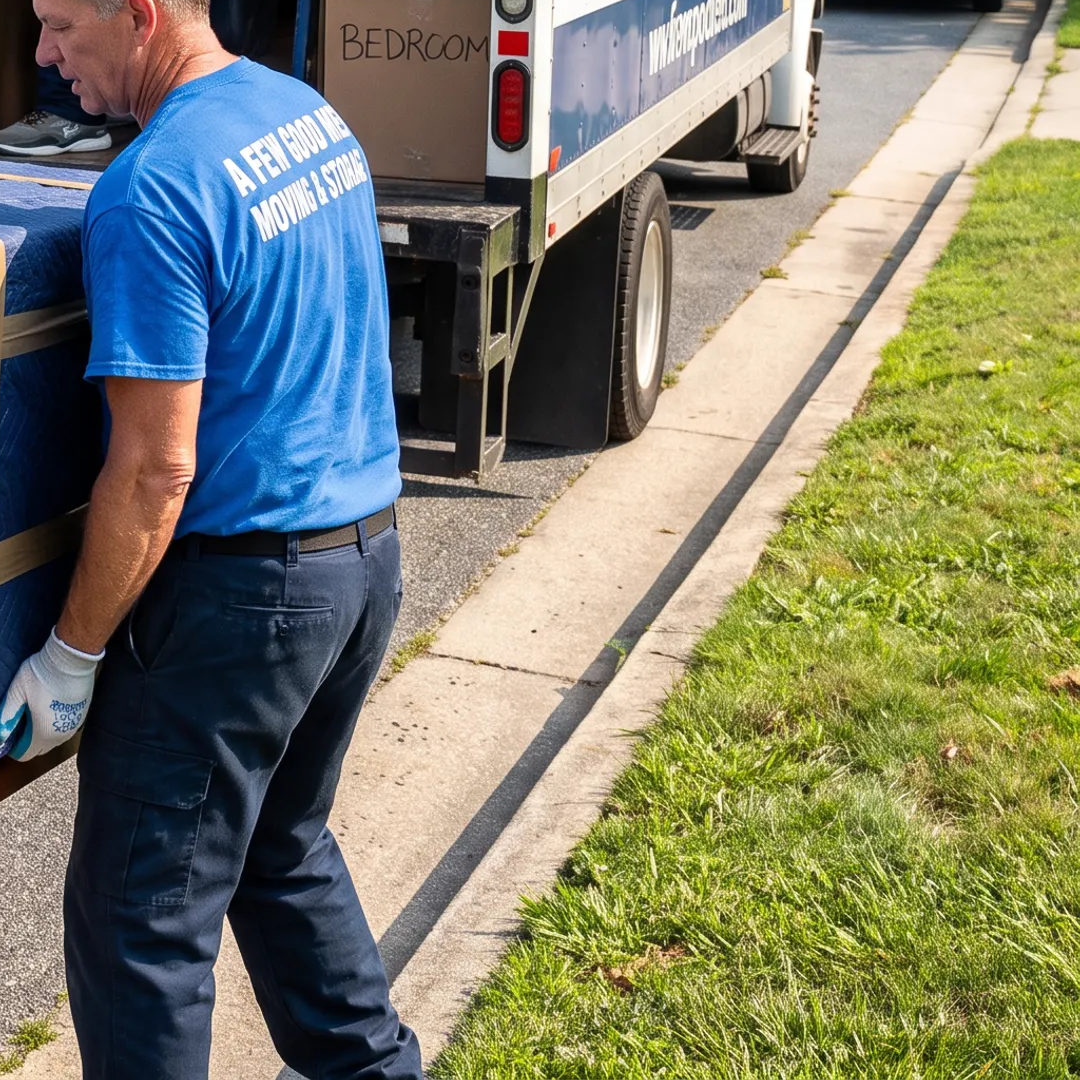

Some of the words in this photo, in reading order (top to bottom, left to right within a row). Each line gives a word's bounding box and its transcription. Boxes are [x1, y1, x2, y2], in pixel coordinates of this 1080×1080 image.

[340, 23, 489, 62] BEDROOM
[277, 114, 329, 163] GOOD
[313, 105, 351, 144] ME
[223, 157, 257, 198] A
[239, 132, 291, 185] FEW
[250, 176, 319, 242] MOVING
[309, 170, 330, 206] &
